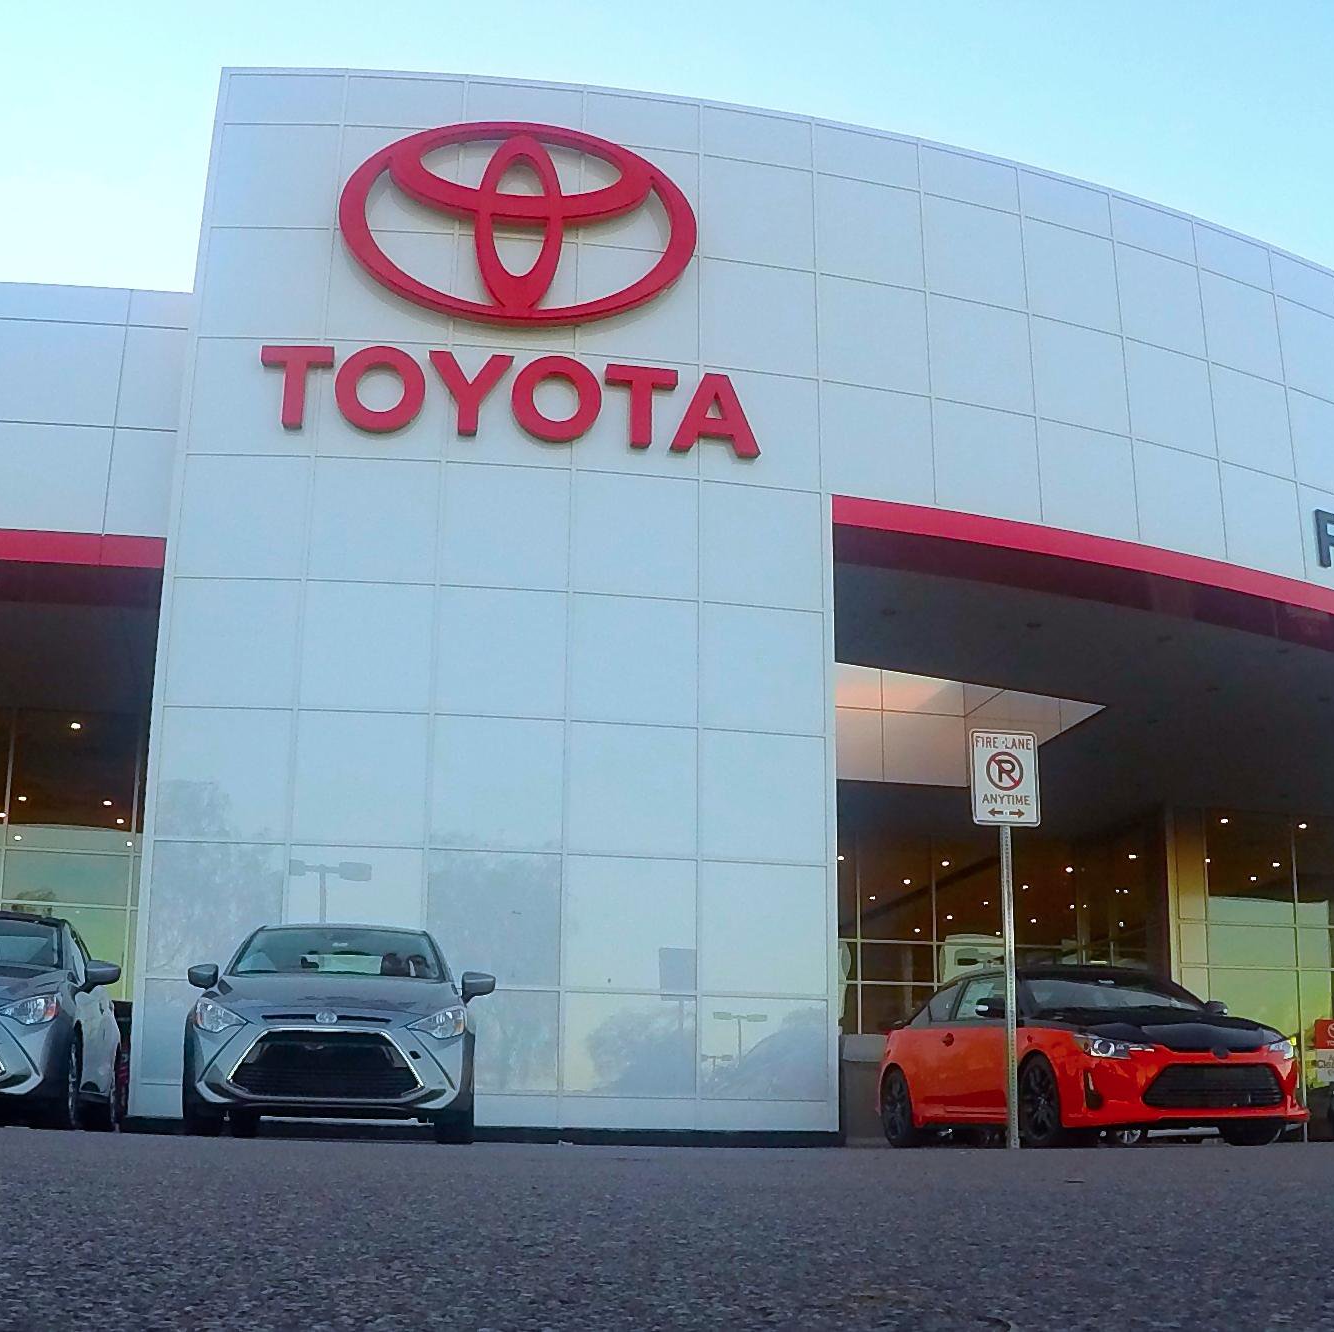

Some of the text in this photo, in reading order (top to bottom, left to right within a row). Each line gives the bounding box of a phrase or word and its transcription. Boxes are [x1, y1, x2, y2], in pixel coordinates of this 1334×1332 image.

[261, 344, 761, 459] TOYOTA
[975, 735, 1032, 751] FIRE LANE
[981, 793, 1031, 806] ANYTIME
